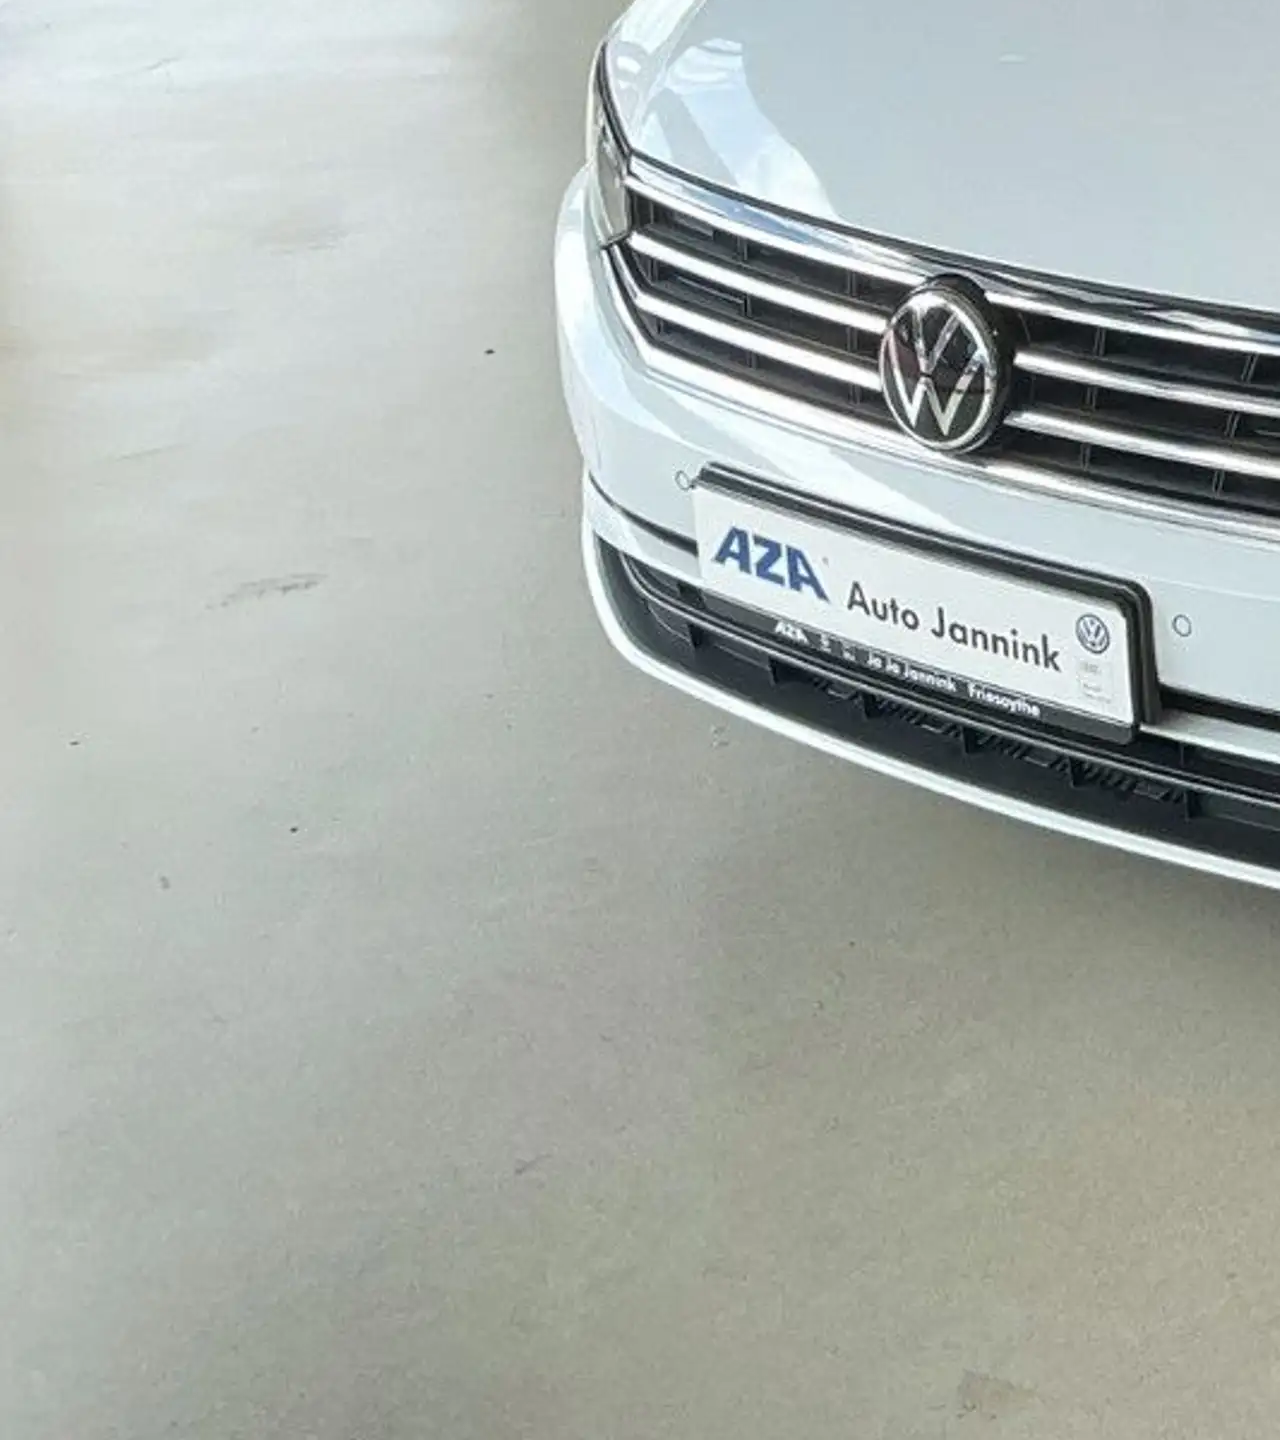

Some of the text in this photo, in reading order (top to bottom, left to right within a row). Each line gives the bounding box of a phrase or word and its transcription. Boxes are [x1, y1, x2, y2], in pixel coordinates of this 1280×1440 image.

[714, 526, 830, 603] AZA
[847, 580, 920, 632] Auto
[931, 606, 1062, 673] Jannink
